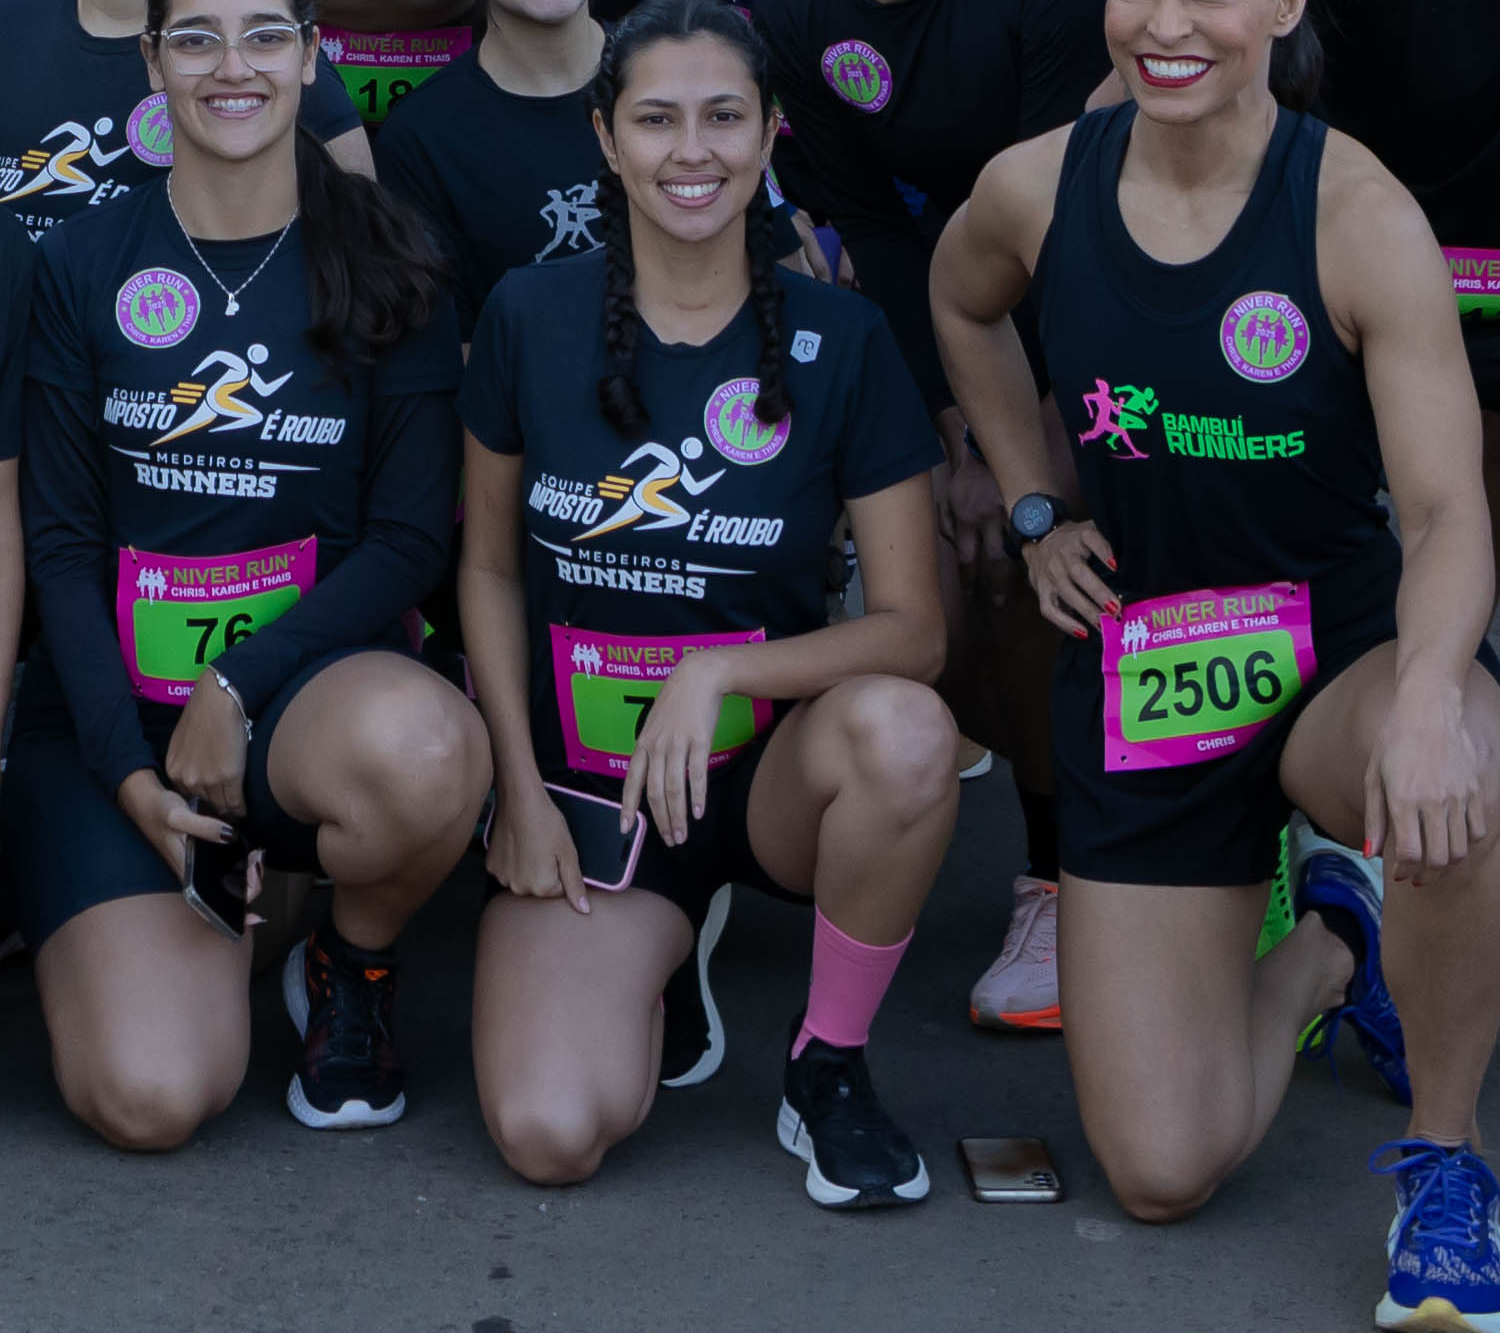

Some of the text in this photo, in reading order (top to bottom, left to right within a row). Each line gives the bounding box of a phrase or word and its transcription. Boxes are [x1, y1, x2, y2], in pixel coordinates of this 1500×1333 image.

[345, 53, 451, 64] CHRIS, KAREN THAIS
[348, 36, 448, 53] NIVER RUN
[825, 42, 879, 67] NIVER RUN
[121, 272, 185, 304] NIVER RUN
[1454, 279, 1485, 291] HRIS,
[1234, 295, 1302, 329] NIVER RUN
[112, 388, 167, 404] EQUIPE
[719, 381, 760, 402] NIVER
[103, 399, 178, 430] IMPOSTO
[260, 409, 346, 445] É ROUBO
[1162, 414, 1244, 437] BAMBUÍ
[1164, 429, 1305, 461] RUNNERS
[155, 451, 255, 470] MEDEIROS
[136, 462, 278, 499] RUNNERS
[540, 473, 594, 497] EQUIPE
[528, 482, 605, 525] IMPOSTO
[686, 506, 784, 547] É ROUBO
[172, 554, 289, 585] NIVER RUN
[578, 548, 681, 571] MEDEIROS
[170, 571, 293, 599] CHRIS, KAREN THAIS
[554, 556, 706, 600] RUNNERS
[1151, 596, 1276, 628] NIVER RUN
[185, 613, 255, 665] 76
[1151, 614, 1280, 644] CHRIS, KAREN THAIS
[606, 643, 676, 664] NIVER
[605, 663, 676, 677] CHRIS, KAR
[1137, 650, 1283, 723] 2506
[1196, 735, 1236, 751] CHRIS
